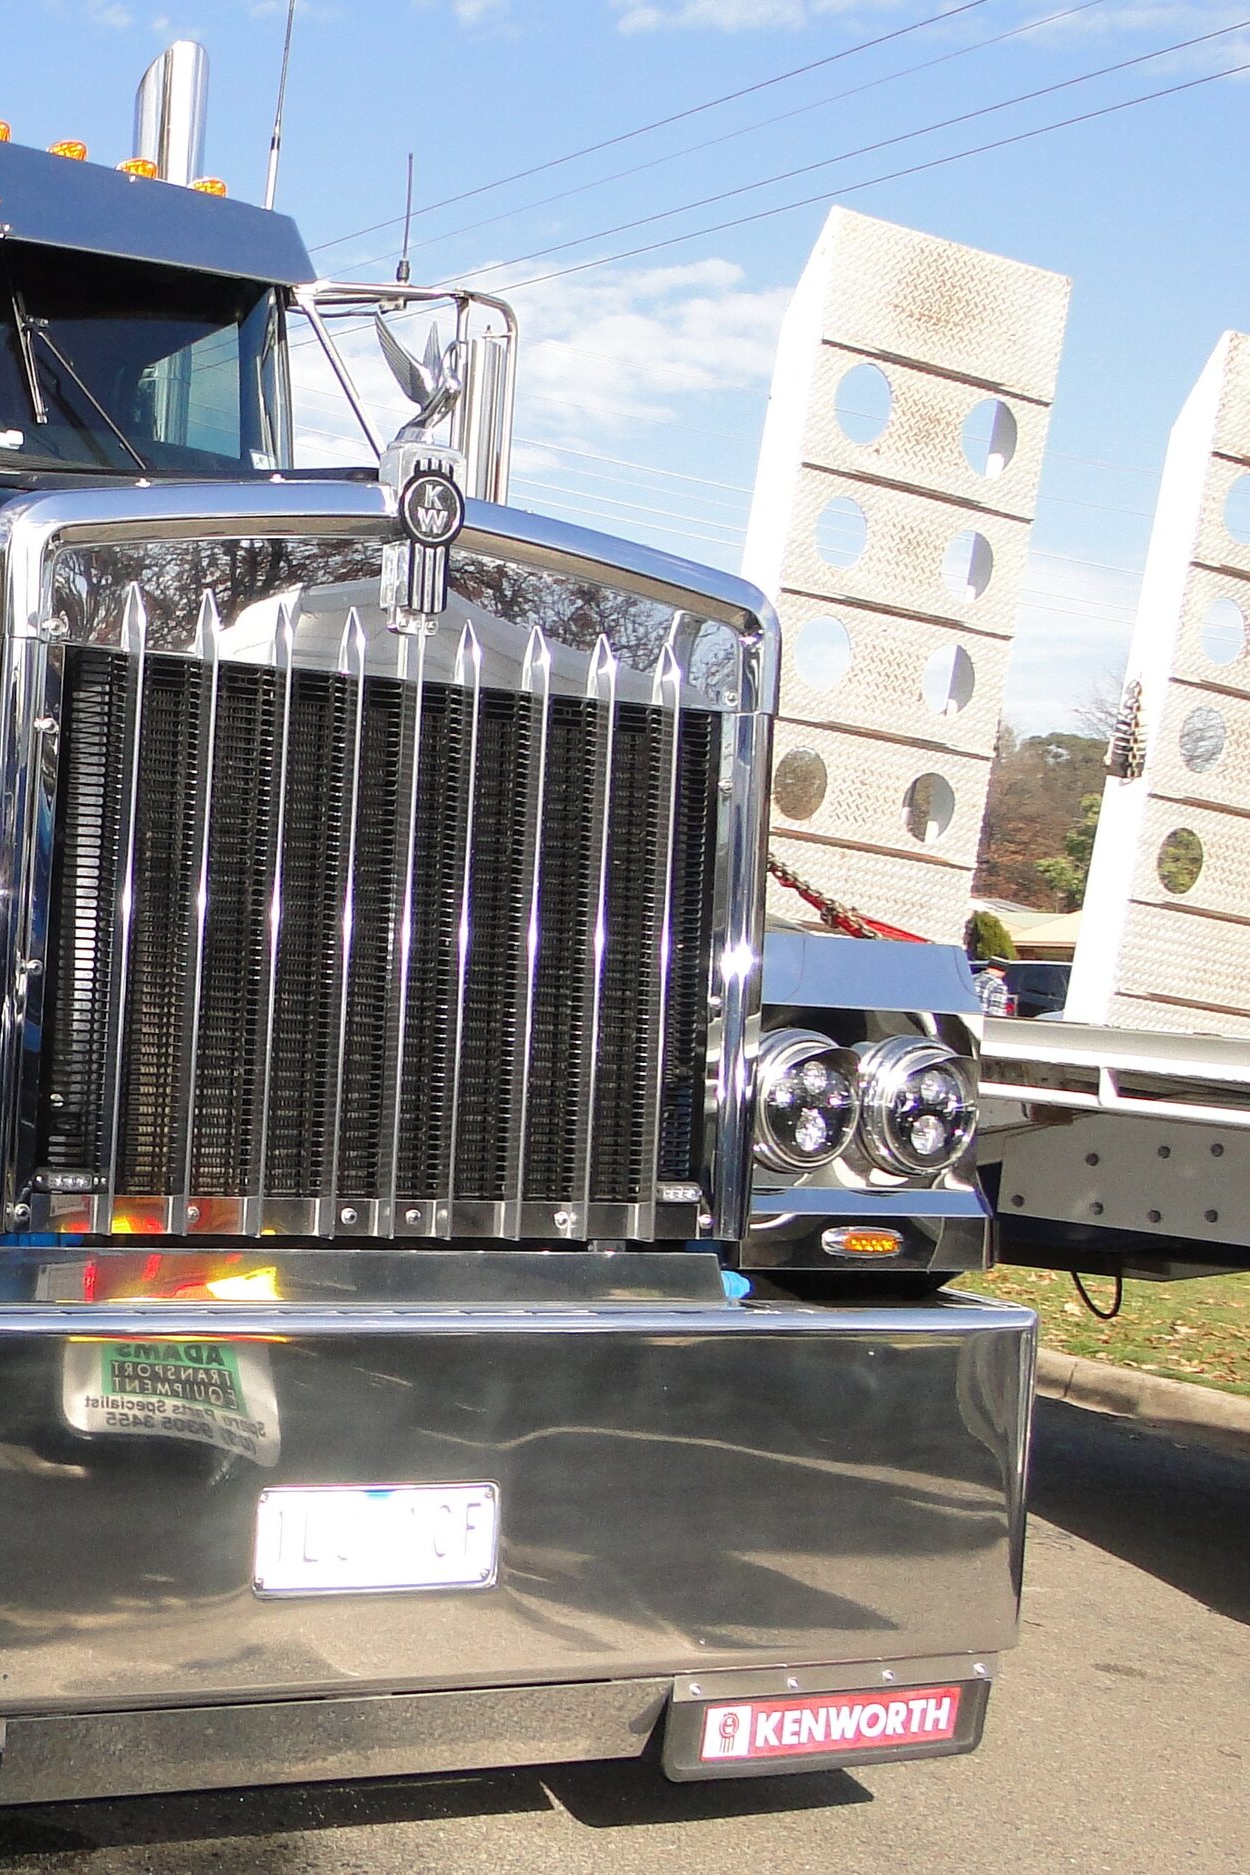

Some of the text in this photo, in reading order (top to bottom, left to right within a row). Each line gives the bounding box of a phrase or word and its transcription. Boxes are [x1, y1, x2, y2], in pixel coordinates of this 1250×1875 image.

[423, 484, 444, 510] K
[417, 507, 448, 534] W
[754, 1696, 952, 1748] KENWORTH
